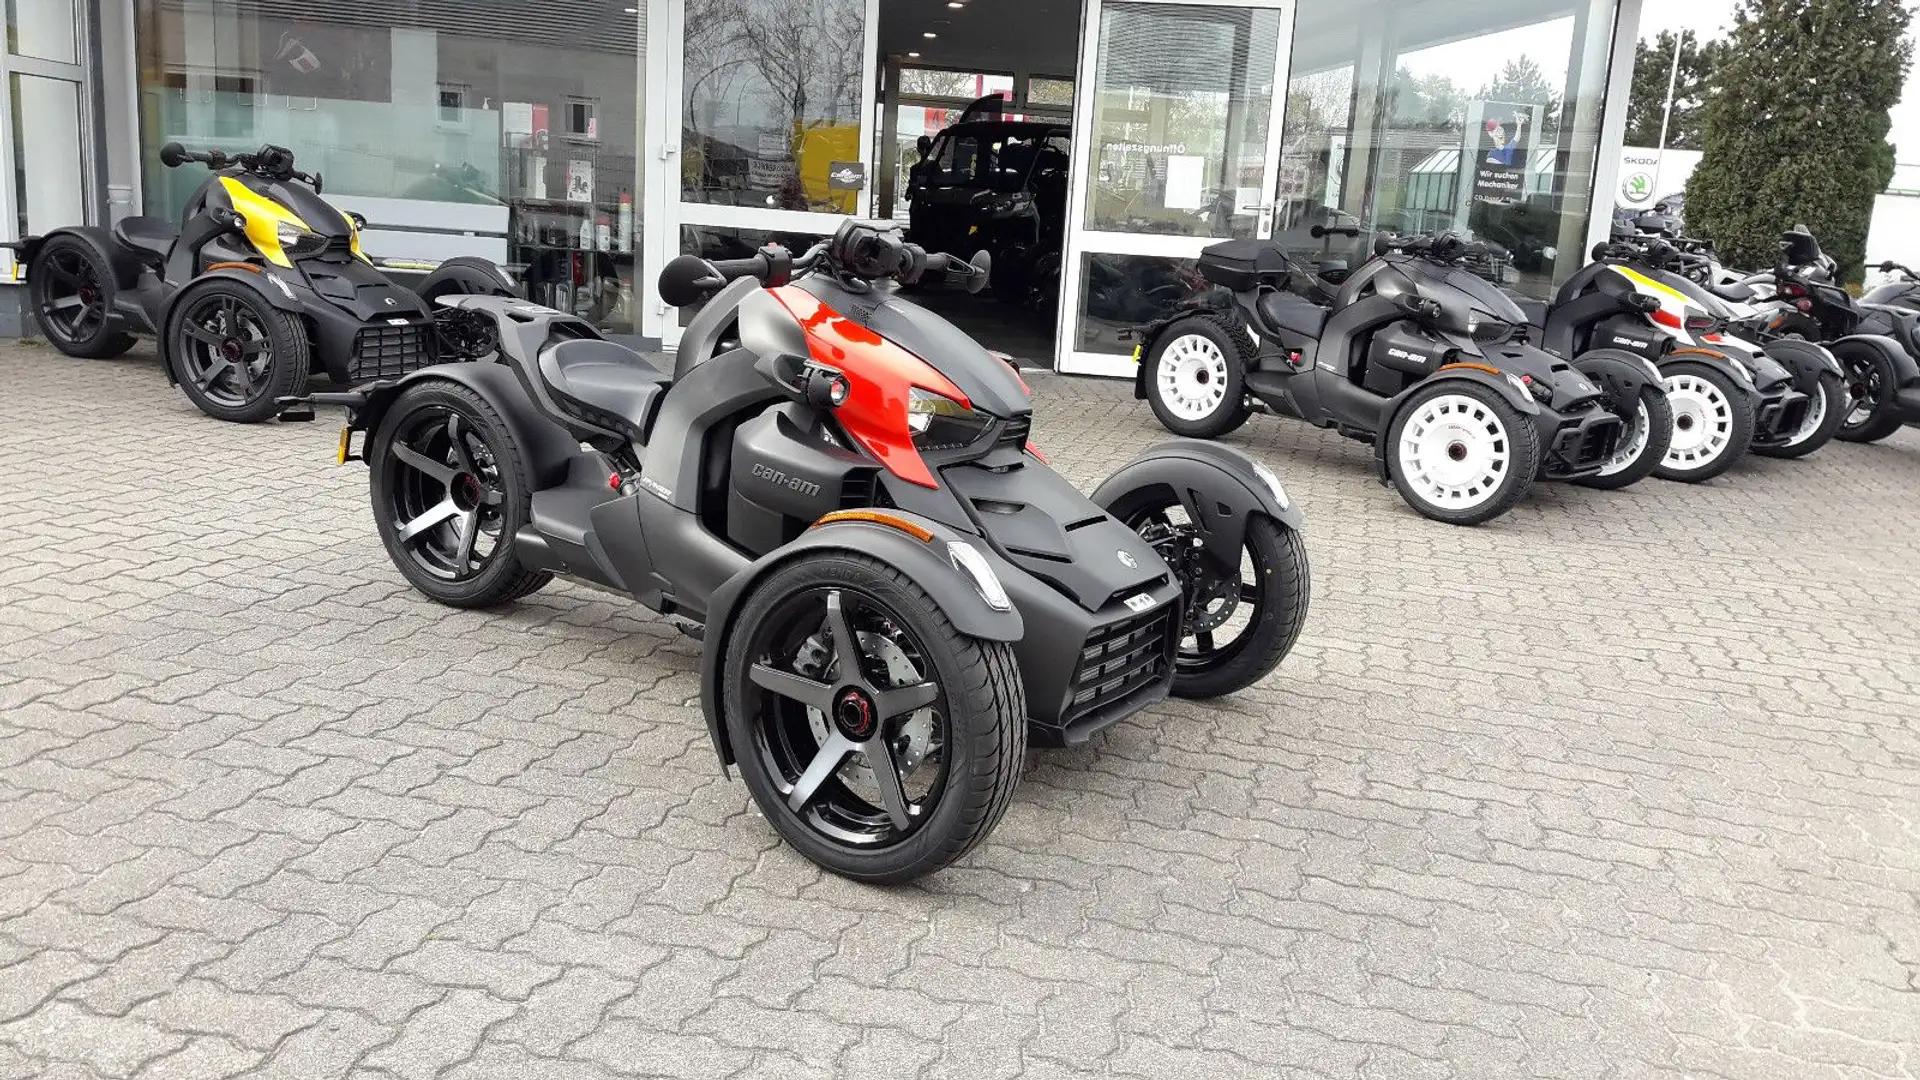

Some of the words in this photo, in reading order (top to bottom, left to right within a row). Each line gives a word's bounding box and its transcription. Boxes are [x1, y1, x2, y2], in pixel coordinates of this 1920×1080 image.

[1480, 170, 1493, 178] Wir
[1494, 171, 1519, 180] suchen
[1477, 180, 1519, 190] Mechaniker
[751, 463, 821, 497] can-am
